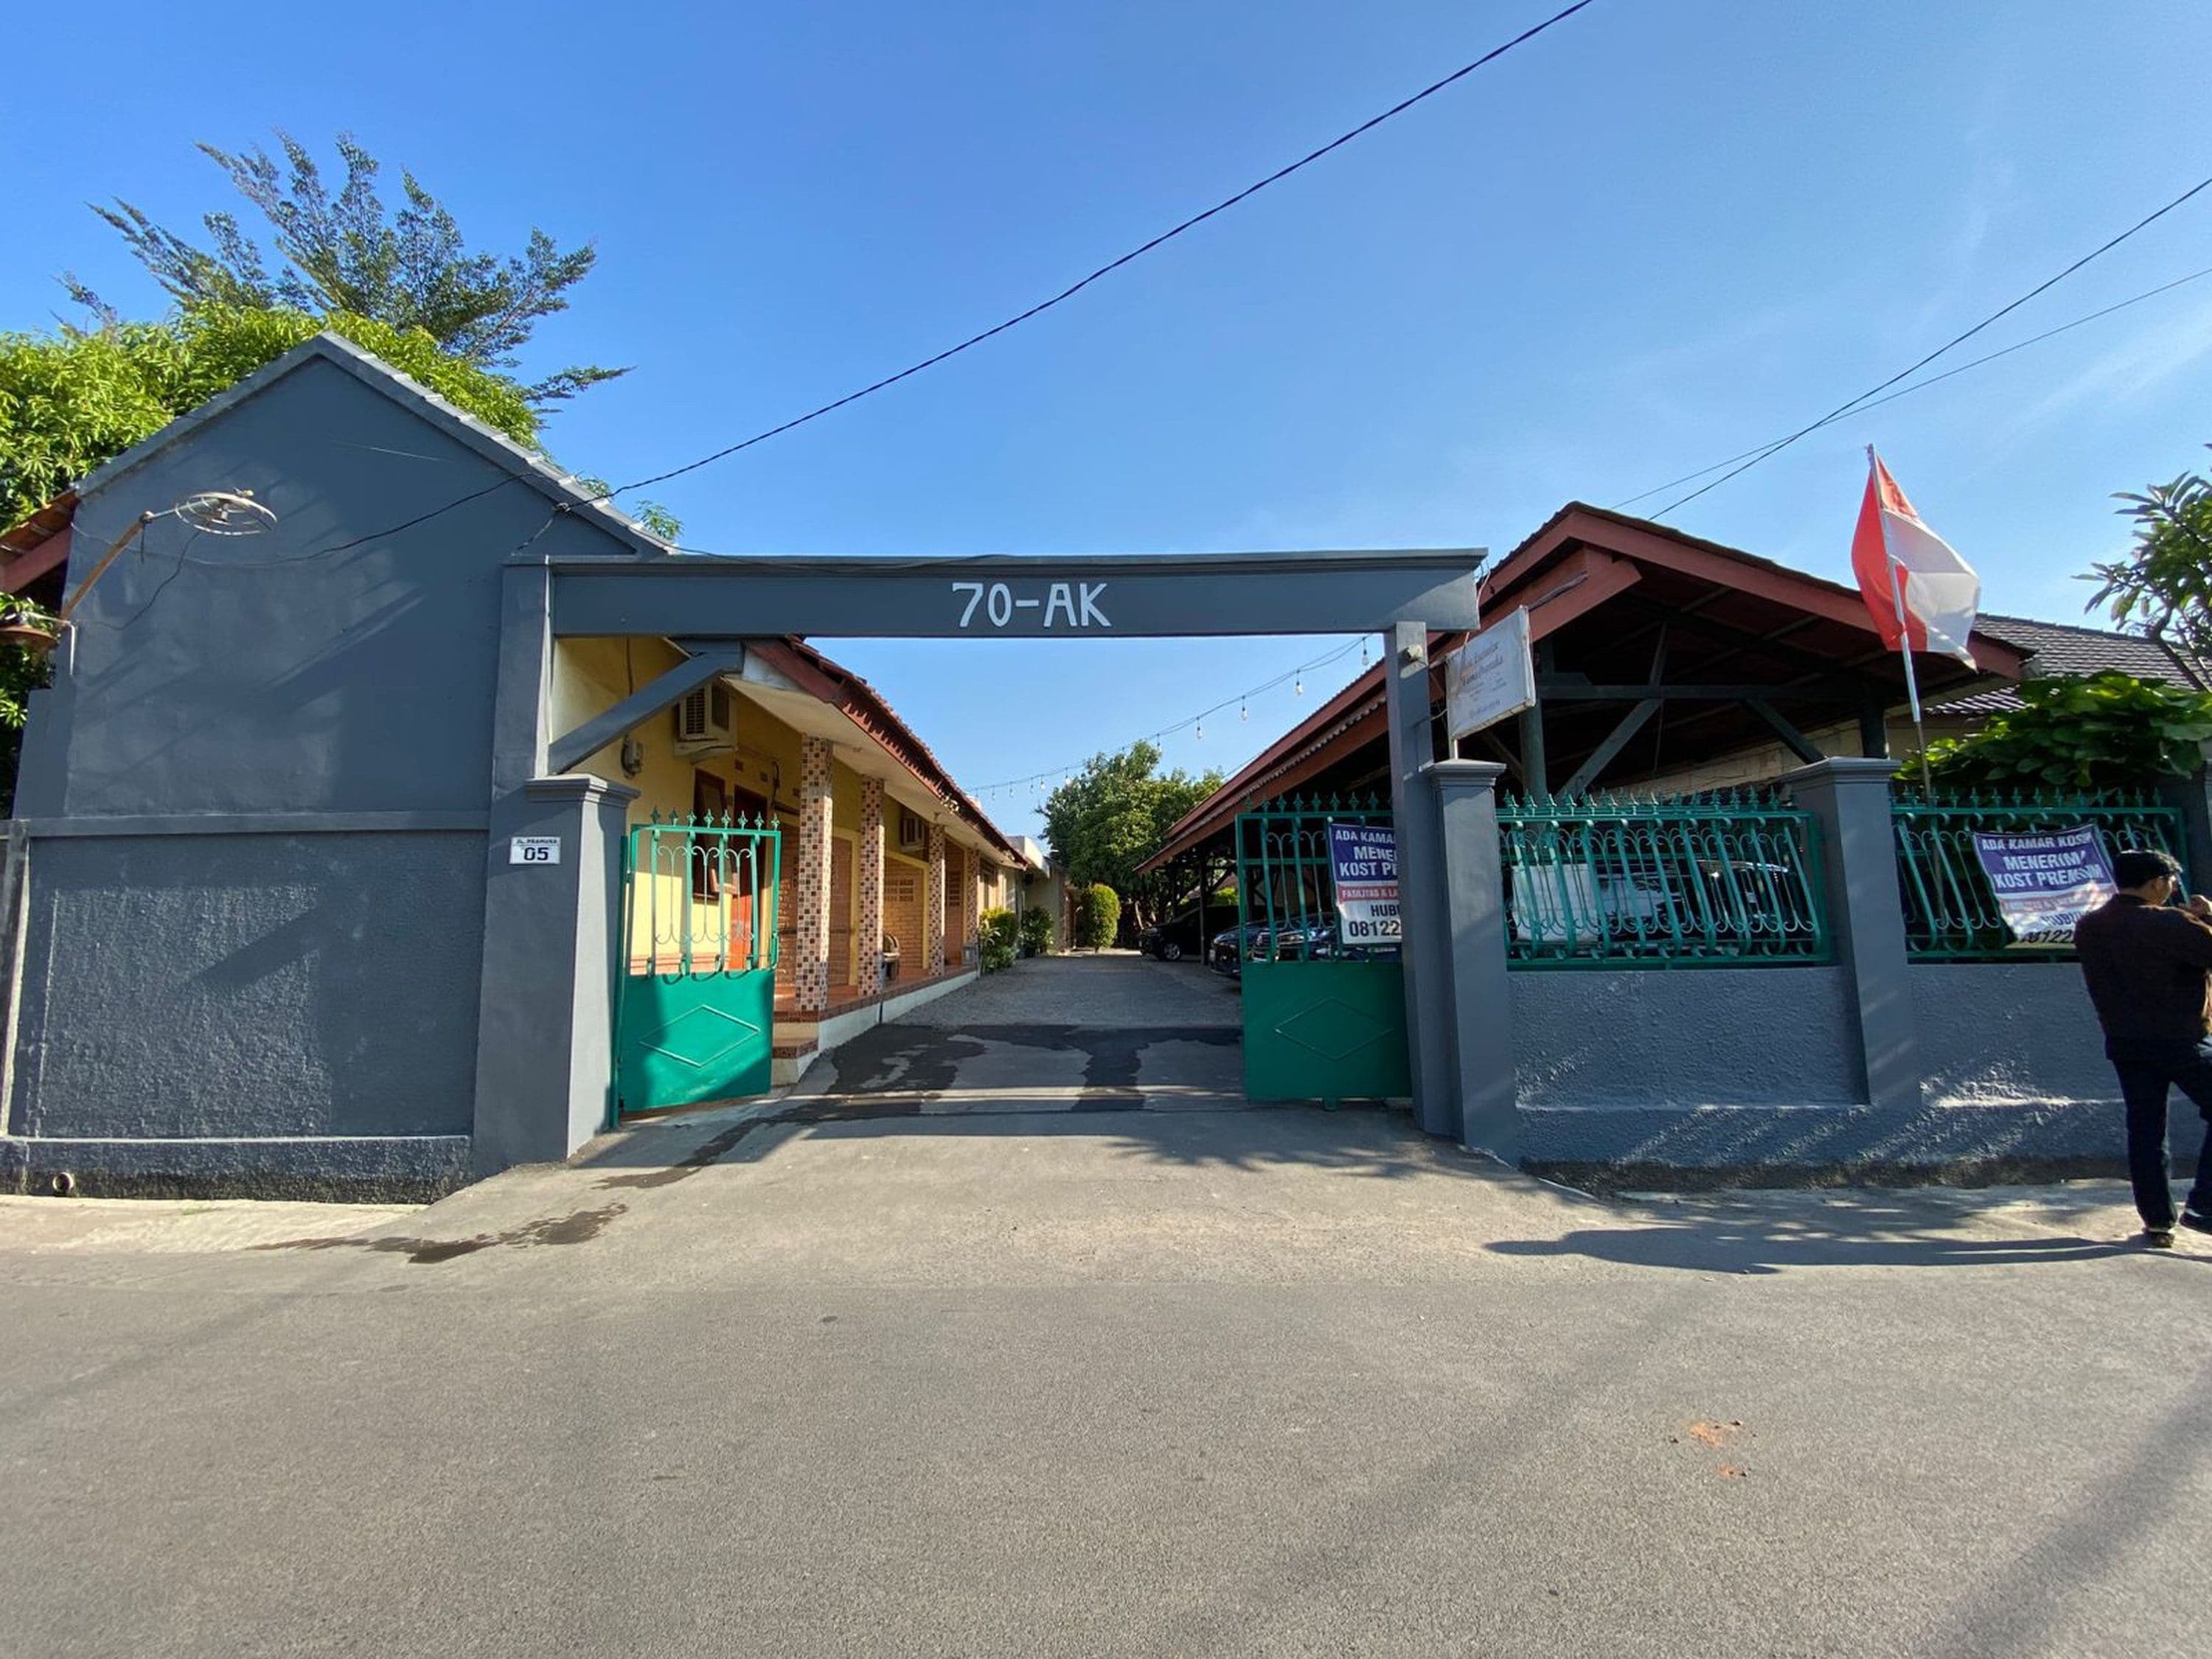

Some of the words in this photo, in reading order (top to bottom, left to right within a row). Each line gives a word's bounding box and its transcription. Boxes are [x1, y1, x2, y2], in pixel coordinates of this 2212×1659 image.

[952, 582, 1113, 627] 70-AK
[1335, 830, 1358, 841] ADA
[1360, 832, 1396, 844] KAMA
[1981, 839, 2006, 850] ADA
[2008, 836, 2055, 849] KAMAR
[524, 846, 549, 861] 05
[1353, 846, 1397, 862] MENE
[1339, 862, 1377, 877] KOST
[1993, 872, 2032, 888] KOST
